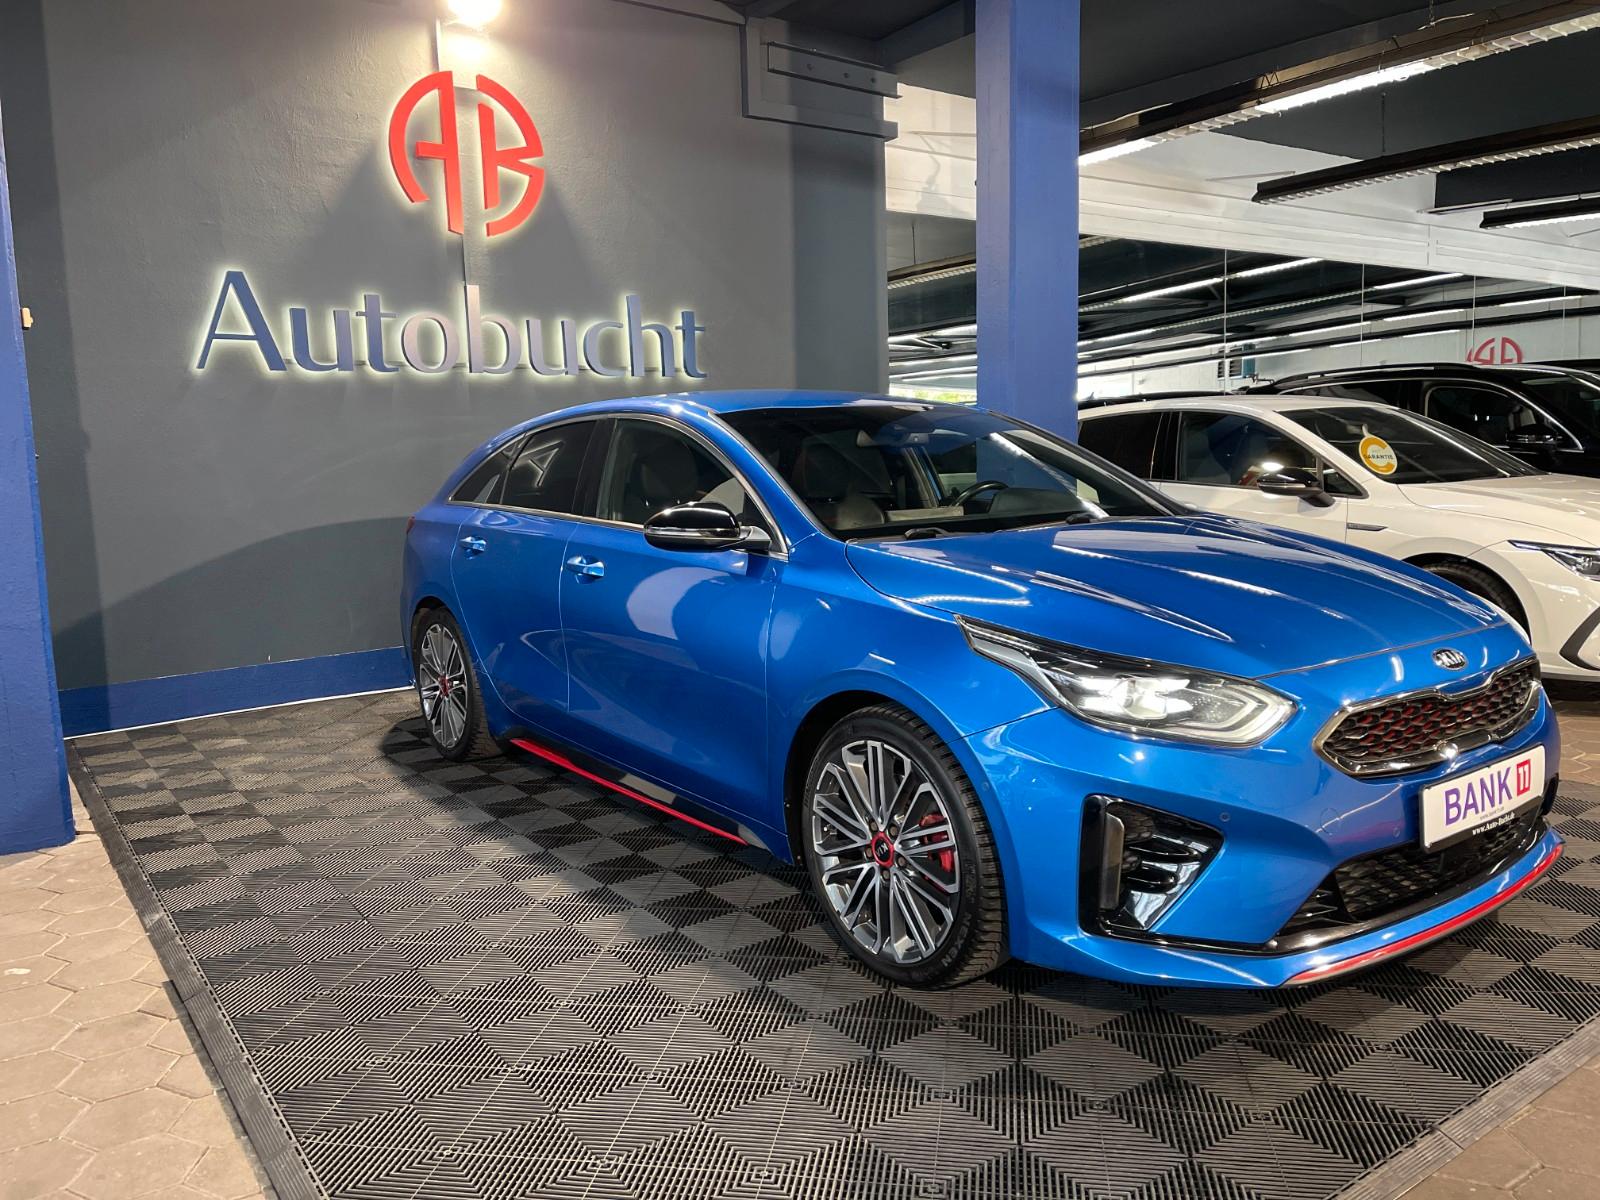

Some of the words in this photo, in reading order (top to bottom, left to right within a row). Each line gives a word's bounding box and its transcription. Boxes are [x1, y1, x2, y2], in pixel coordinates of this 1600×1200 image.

[196, 271, 708, 378] Autobucht
[1436, 650, 1464, 667] KIA
[1445, 767, 1512, 825] BANK
